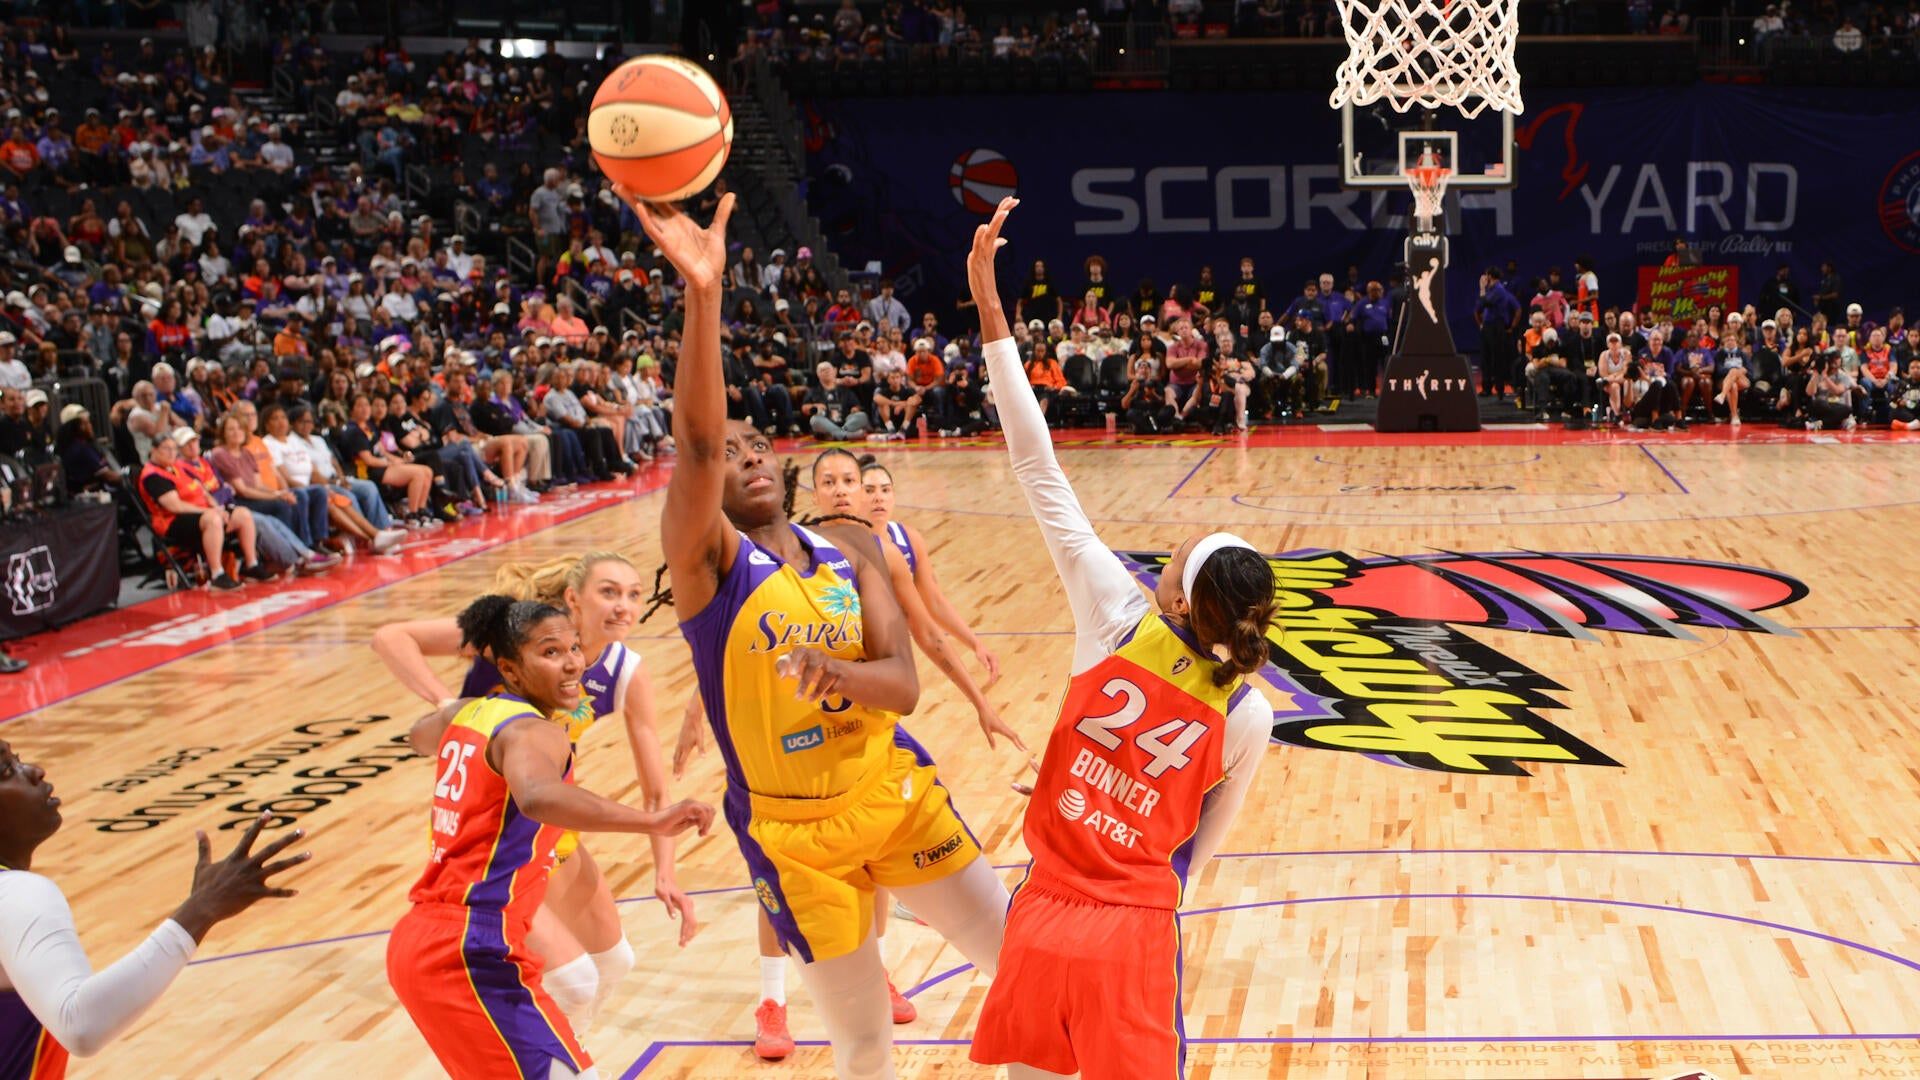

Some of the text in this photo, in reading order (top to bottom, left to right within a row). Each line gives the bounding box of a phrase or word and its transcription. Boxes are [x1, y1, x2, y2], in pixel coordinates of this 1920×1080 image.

[1580, 161, 1799, 235] YARD
[1413, 233, 1440, 248] ally
[1719, 233, 1774, 256] Bally
[1371, 624, 1523, 688] Phoenix
[787, 718, 863, 750] UCLA Health
[1076, 678, 1211, 779] 24
[91, 747, 221, 794] center
[219, 734, 427, 832] ortgage
[434, 740, 476, 802] 25
[1070, 748, 1161, 818] BONNER
[927, 835, 963, 862] WNBA
[1084, 809, 1143, 850] AT&T
[1334, 1044, 1467, 1056] Monique
[1479, 1043, 1598, 1053] Ambers
[1616, 1042, 1732, 1052] Kristine
[1745, 1041, 1854, 1053] Anigwe
[1683, 1055, 1847, 1065] Bass-Boyd
